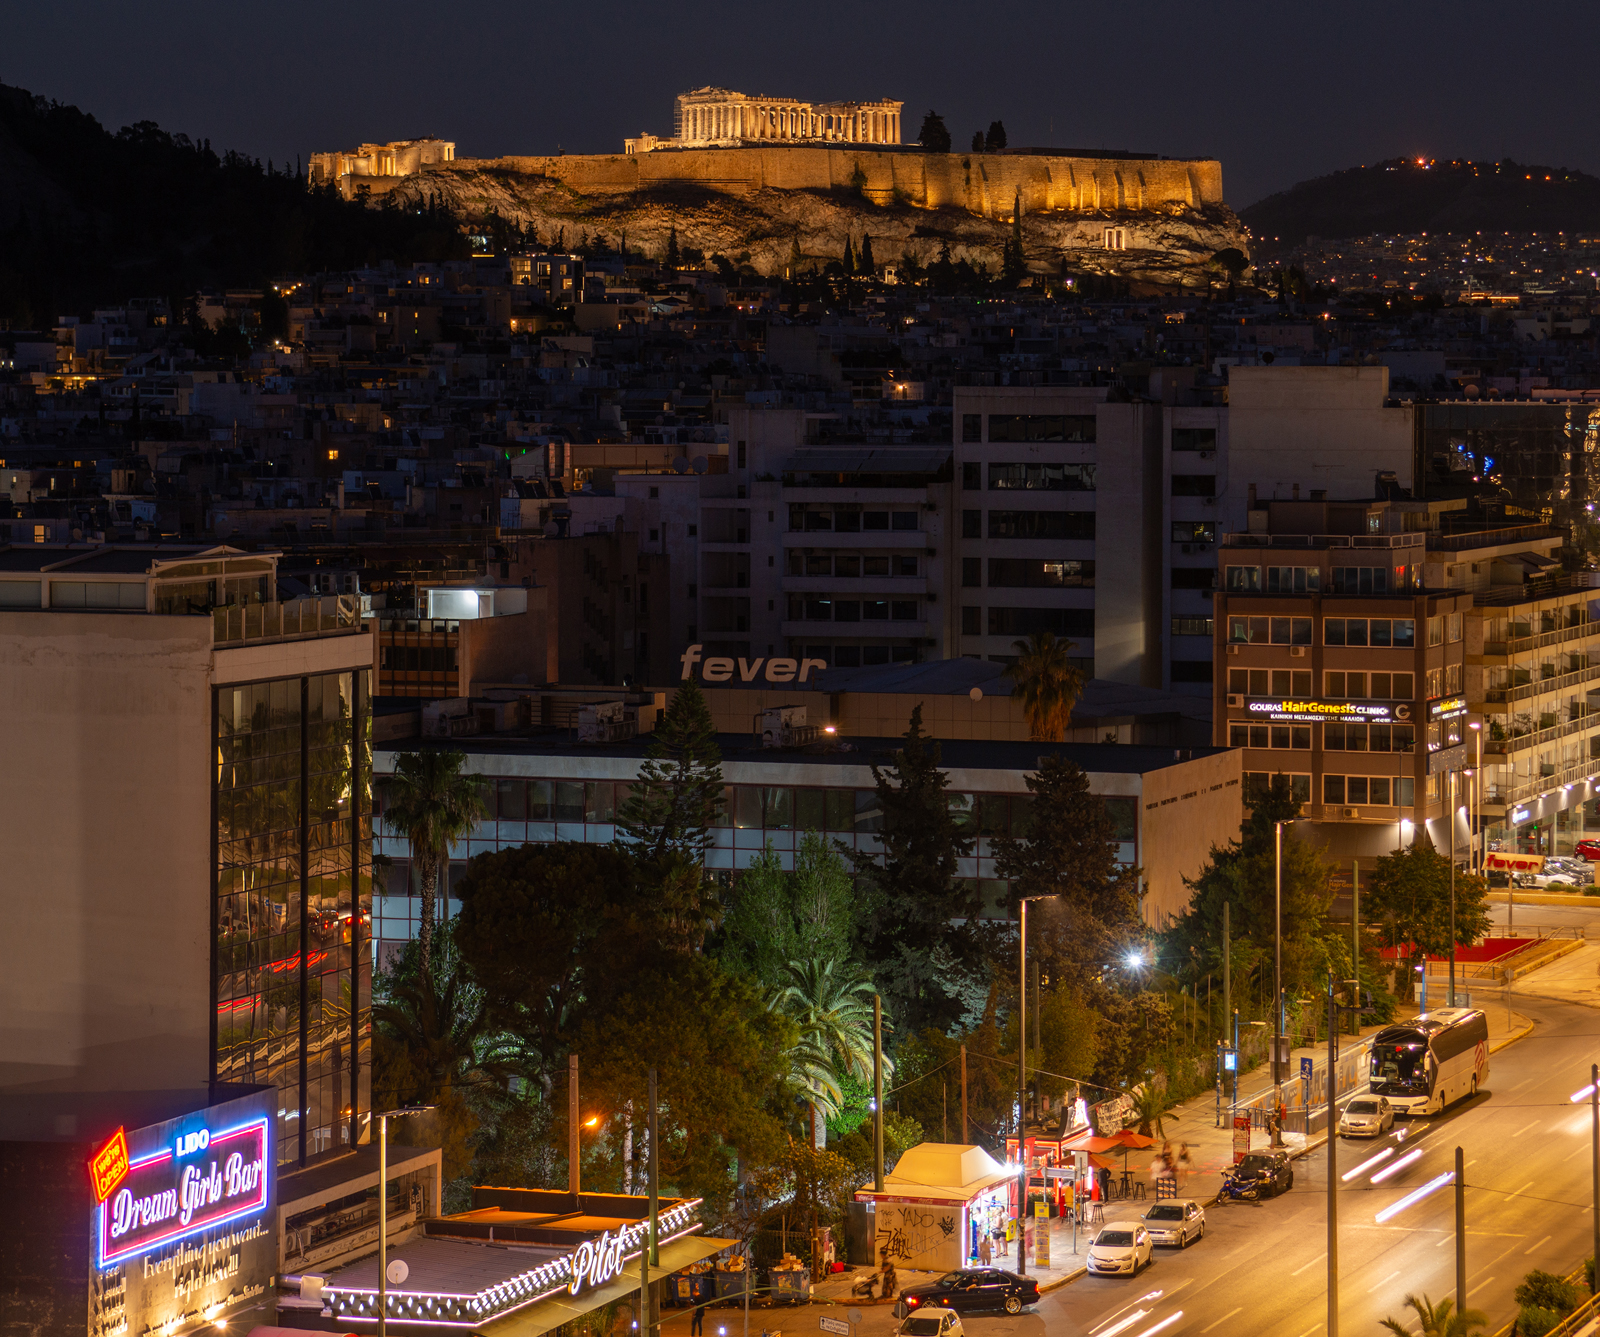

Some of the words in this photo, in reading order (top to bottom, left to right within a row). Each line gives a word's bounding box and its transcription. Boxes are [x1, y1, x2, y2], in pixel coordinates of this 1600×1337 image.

[680, 644, 827, 682] fever
[1249, 703, 1282, 712] GOURAS
[1282, 701, 1356, 713] HairGenesis
[1487, 854, 1539, 870] fever
[176, 1129, 210, 1157] LIDO
[101, 1156, 124, 1192] OPEN
[110, 1188, 178, 1238] Dream
[179, 1161, 223, 1226] Girls
[224, 1152, 262, 1197] Bar
[898, 1208, 934, 1228] YADO
[144, 1242, 206, 1279] Everything
[209, 1235, 230, 1264] you
[569, 1224, 627, 1296] Pilot
[174, 1268, 205, 1306] right
